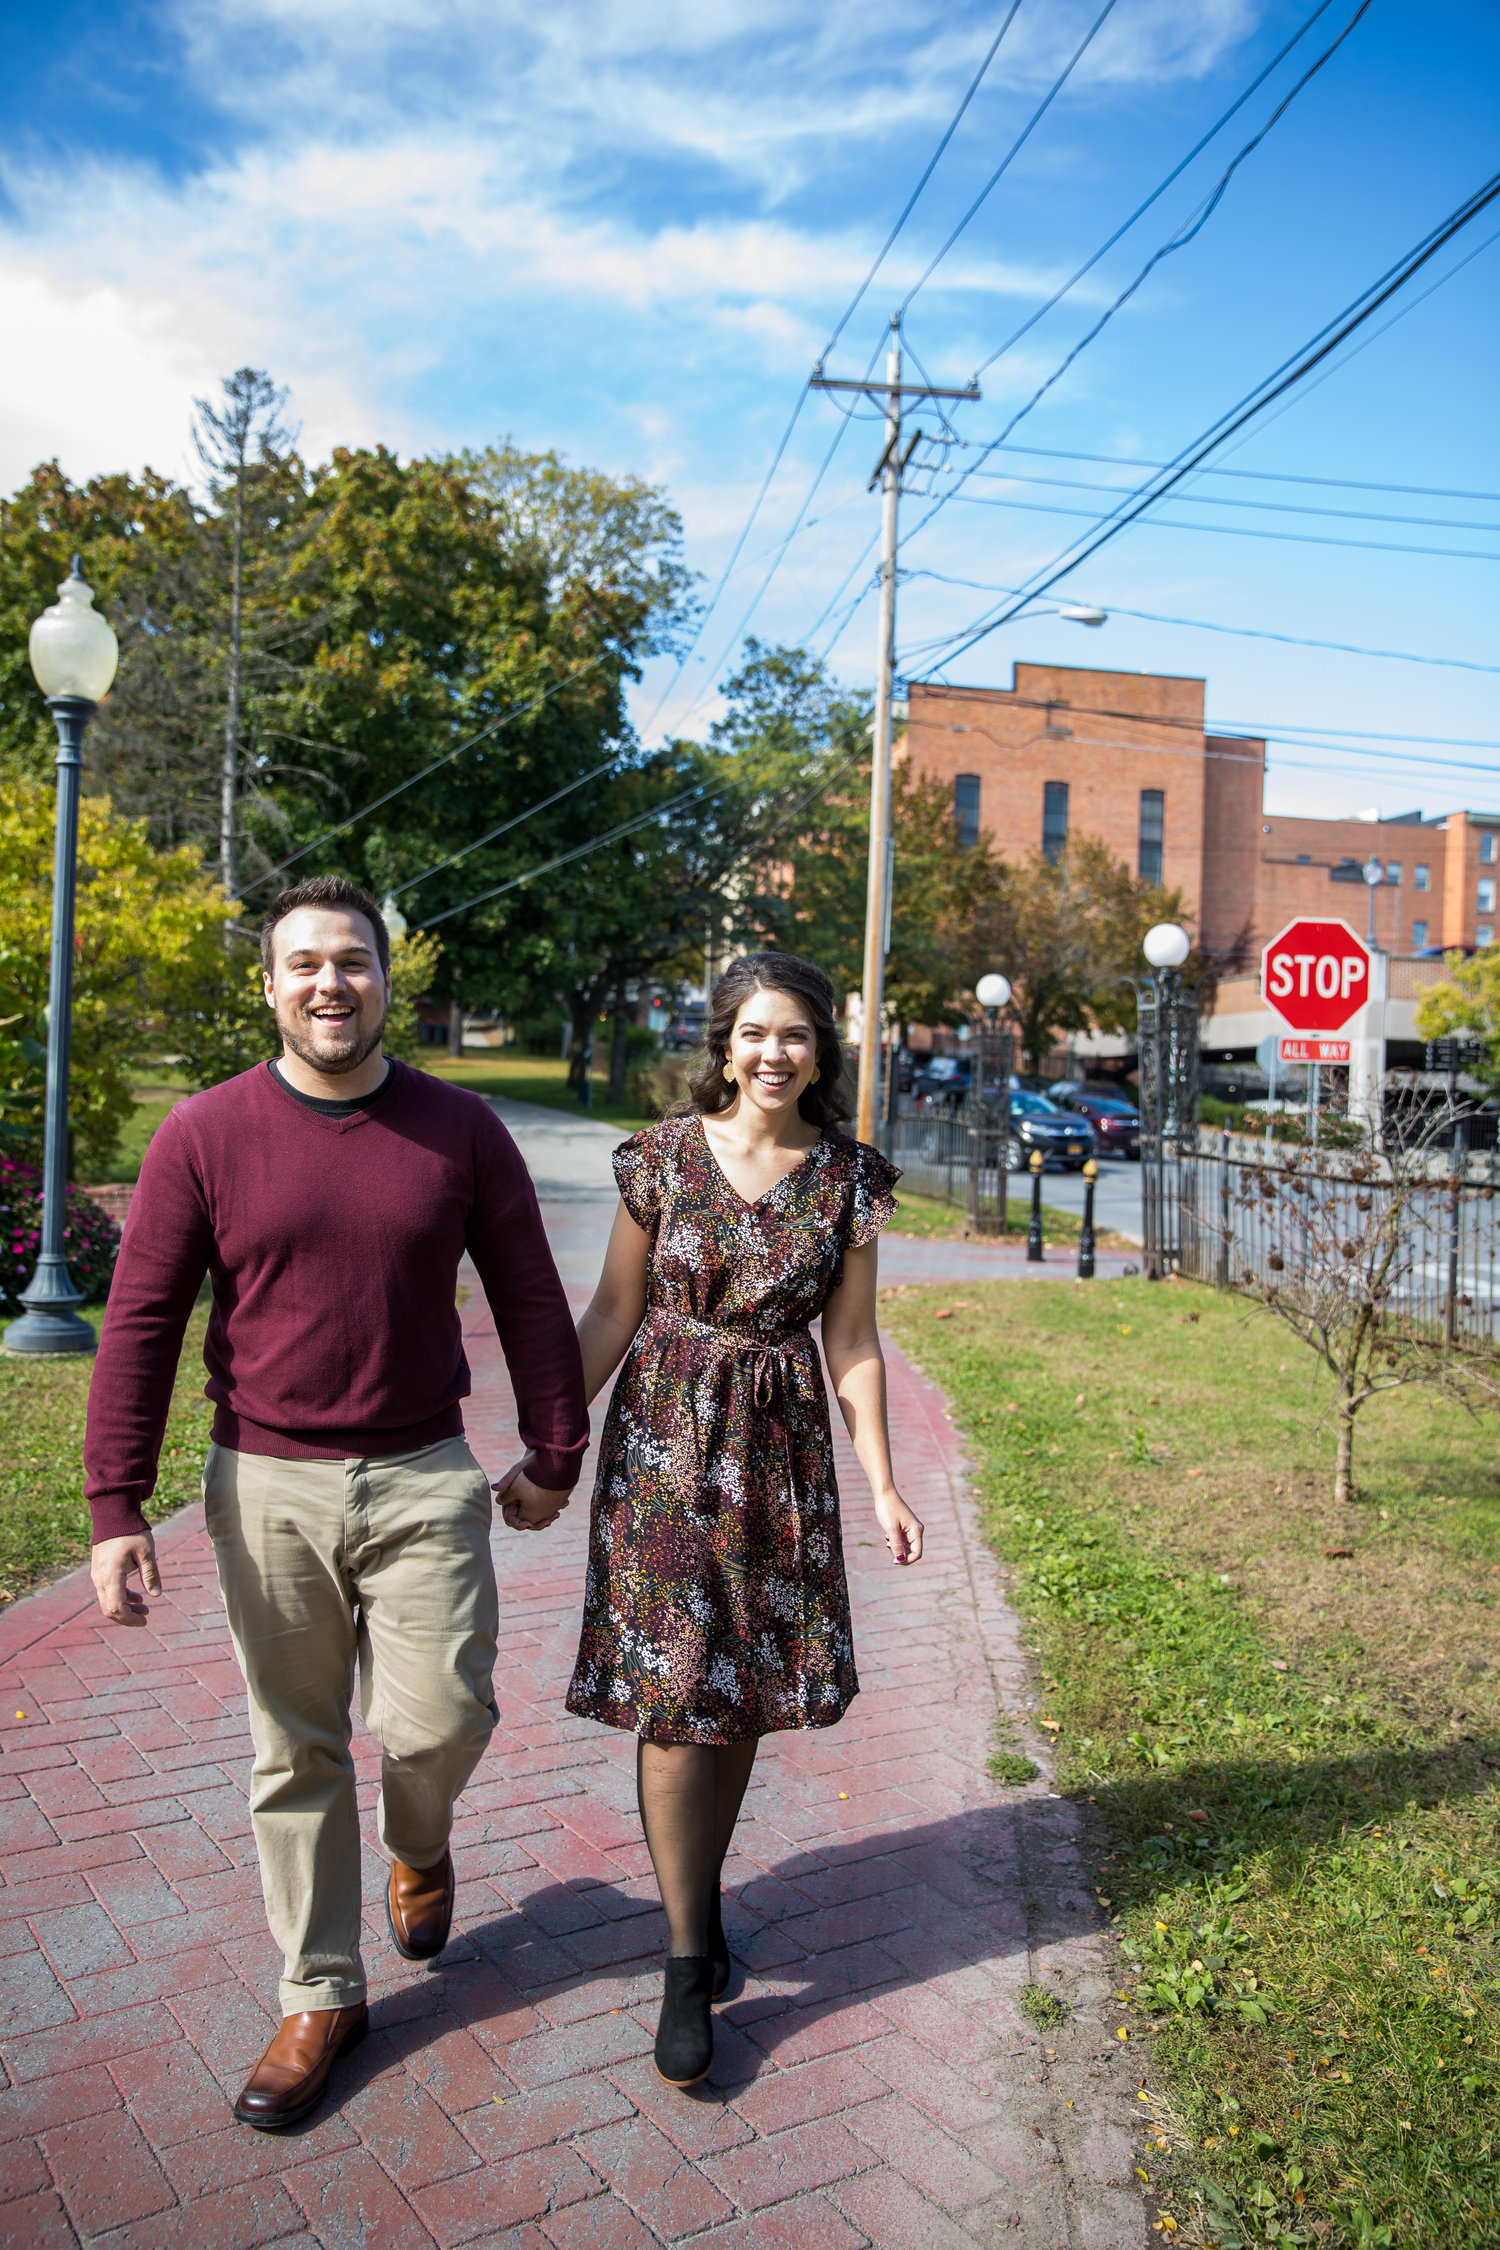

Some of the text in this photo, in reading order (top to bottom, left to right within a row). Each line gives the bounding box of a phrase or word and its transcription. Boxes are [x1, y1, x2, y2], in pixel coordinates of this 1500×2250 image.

[1270, 953, 1366, 999] STOP
[1283, 1042, 1348, 1059] ALL WAY
